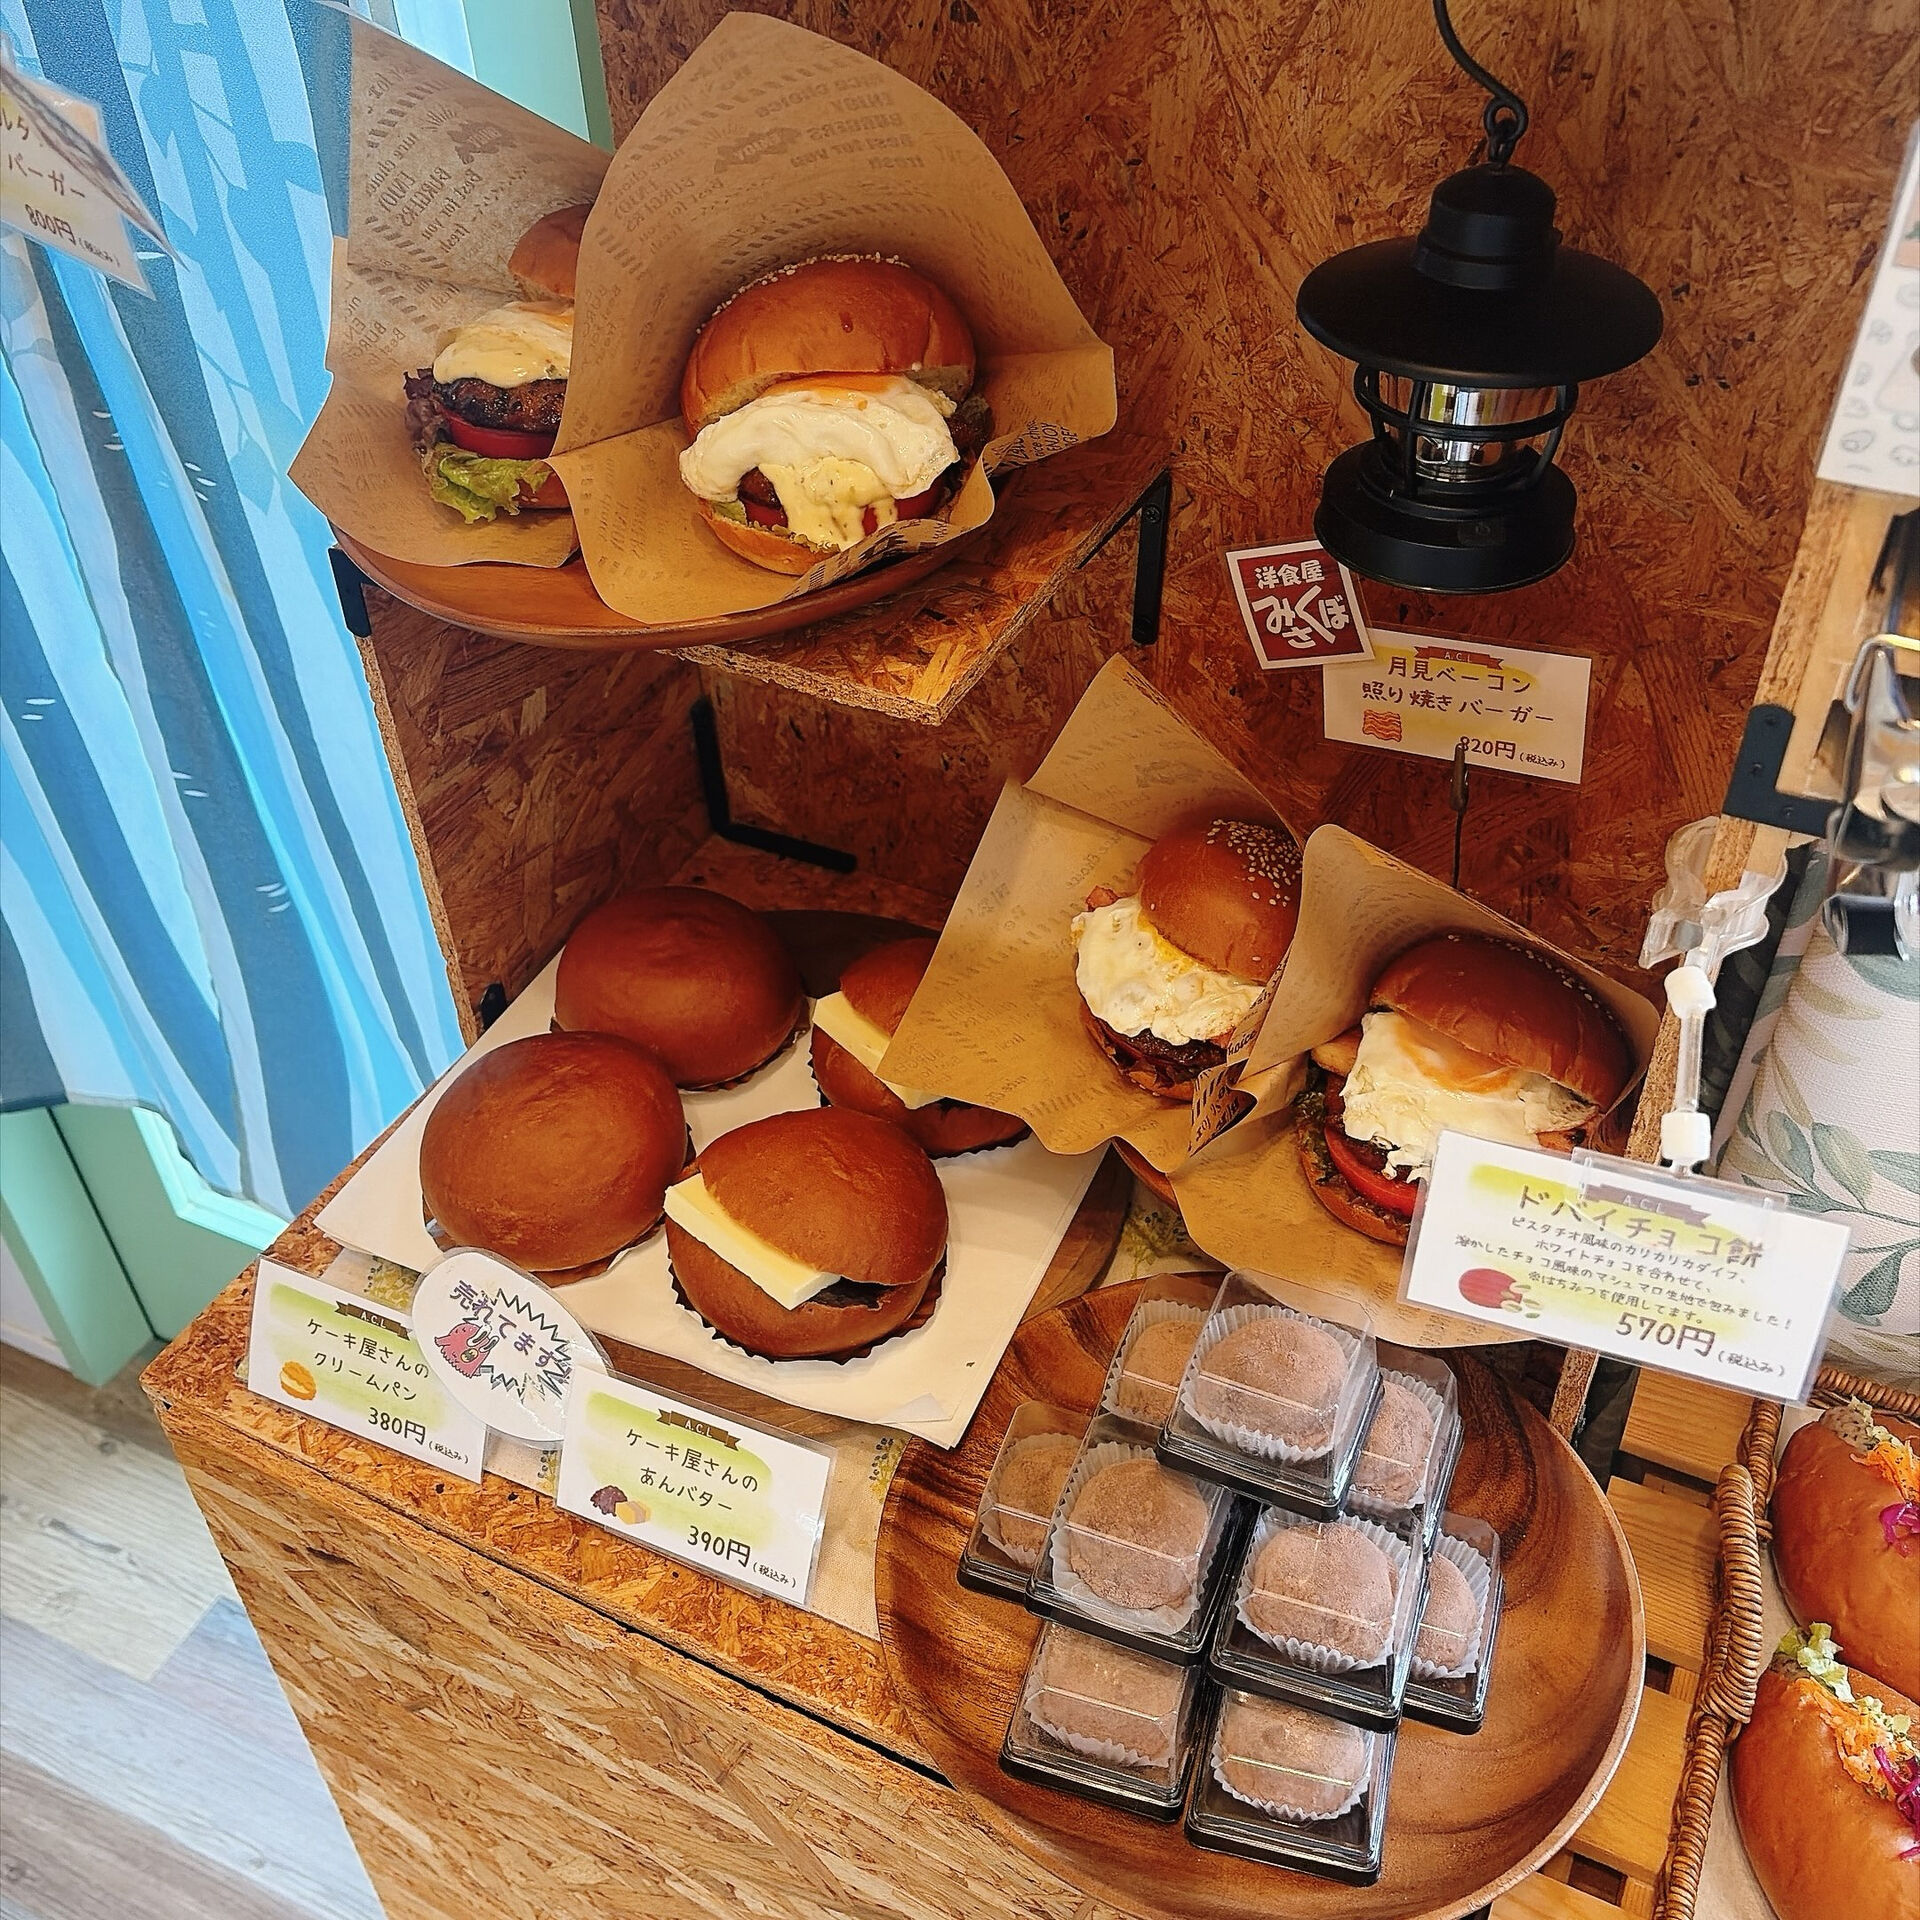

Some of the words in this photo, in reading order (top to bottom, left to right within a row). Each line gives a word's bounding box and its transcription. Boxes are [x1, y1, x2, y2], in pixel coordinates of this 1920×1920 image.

[8, 152, 87, 198] バーガー
[24, 203, 78, 247] 800円
[1253, 559, 1326, 590] 洋食屋
[1388, 656, 1531, 694] 月見ベーコン
[1361, 681, 1555, 724] 照り焼きバーガー
[1459, 736, 1517, 761] 820円
[1519, 753, 1566, 770] (税込み)
[1511, 1216, 1747, 1284] ピスタチオ風味のカリカリカダイフ、
[1517, 1184, 1766, 1268] ドバイチョコ餅
[1534, 1238, 1714, 1293] ホワイトチョコを合わせて、
[306, 1317, 431, 1380] ケーキ屋さんの
[1615, 1313, 1717, 1359] 570円
[1717, 1349, 1787, 1378] (税込み)
[313, 1351, 418, 1402] クリームパン
[368, 1407, 426, 1446] 380円
[428, 1440, 469, 1465] (税込み)
[626, 1429, 760, 1493] ケーキ屋さんの
[639, 1466, 735, 1513] あんバター
[687, 1524, 752, 1568] 390円
[752, 1561, 798, 1589] (税込み)
